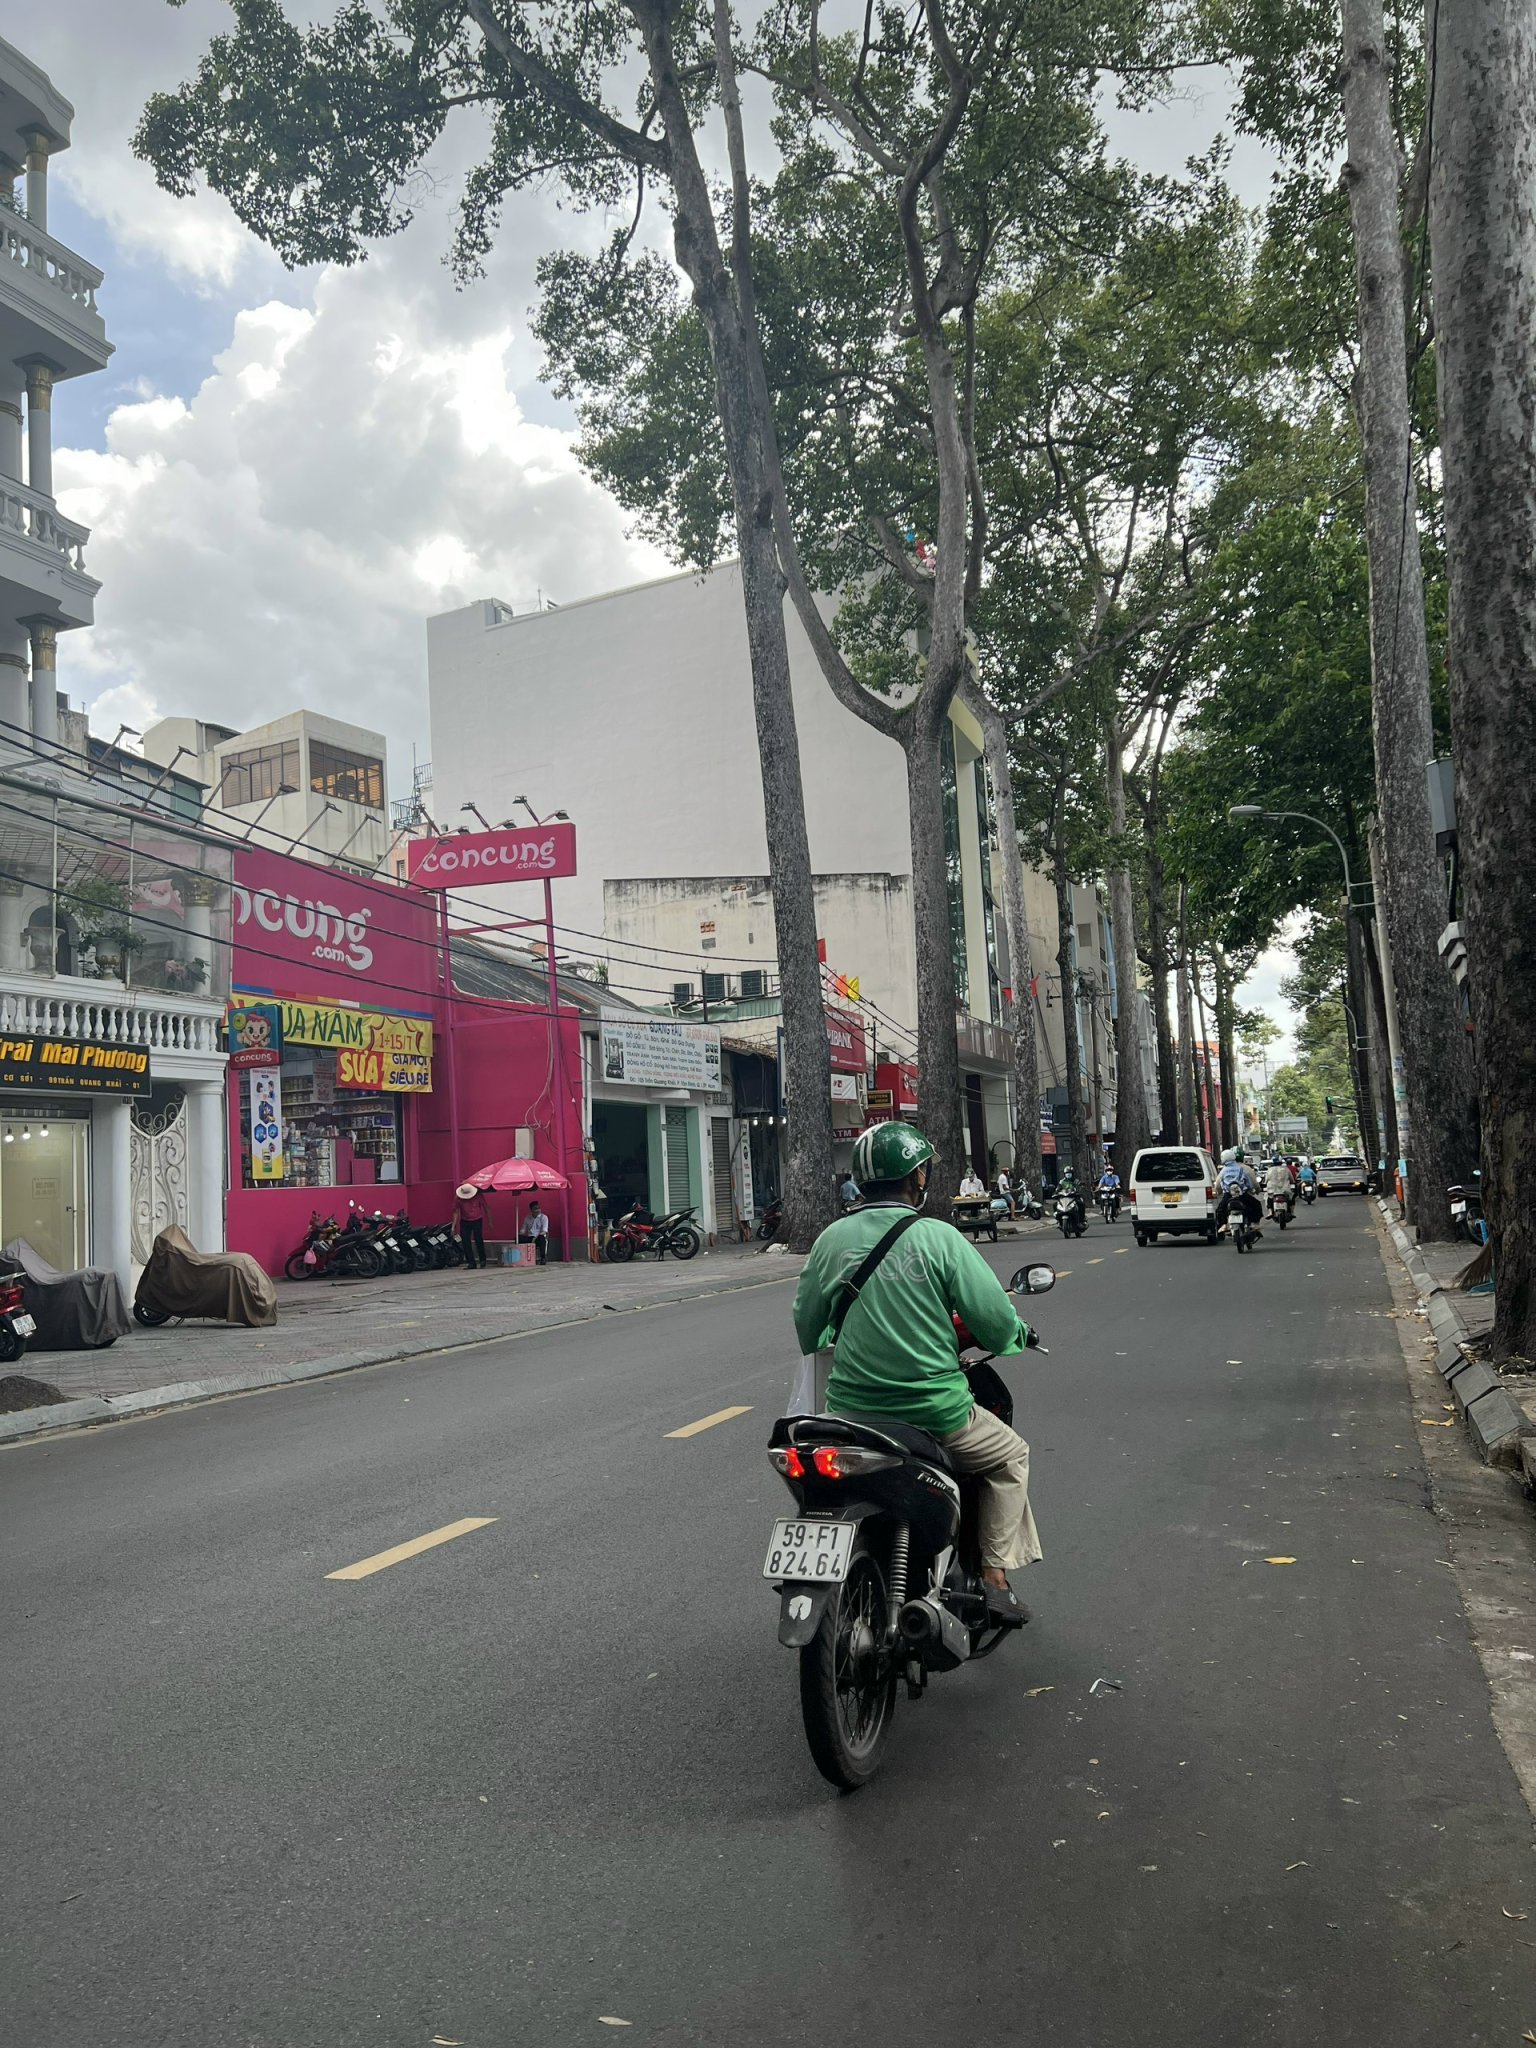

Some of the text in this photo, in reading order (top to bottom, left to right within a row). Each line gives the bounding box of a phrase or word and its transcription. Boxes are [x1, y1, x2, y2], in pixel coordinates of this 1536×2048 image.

[422, 837, 556, 872] concung
[515, 861, 538, 870] .com
[312, 945, 345, 962] .com
[311, 1008, 364, 1046] NĂM
[39, 1042, 80, 1066] Mai
[80, 1046, 148, 1073] Phương
[79, 1078, 102, 1087] QUANG
[388, 1067, 416, 1085] SIÊU
[868, 1116, 890, 1126] ATM
[901, 1137, 926, 1160] Grab
[838, 1241, 930, 1283] Gab
[782, 1524, 839, 1549] 59-F1
[769, 1550, 841, 1577] 824.64
